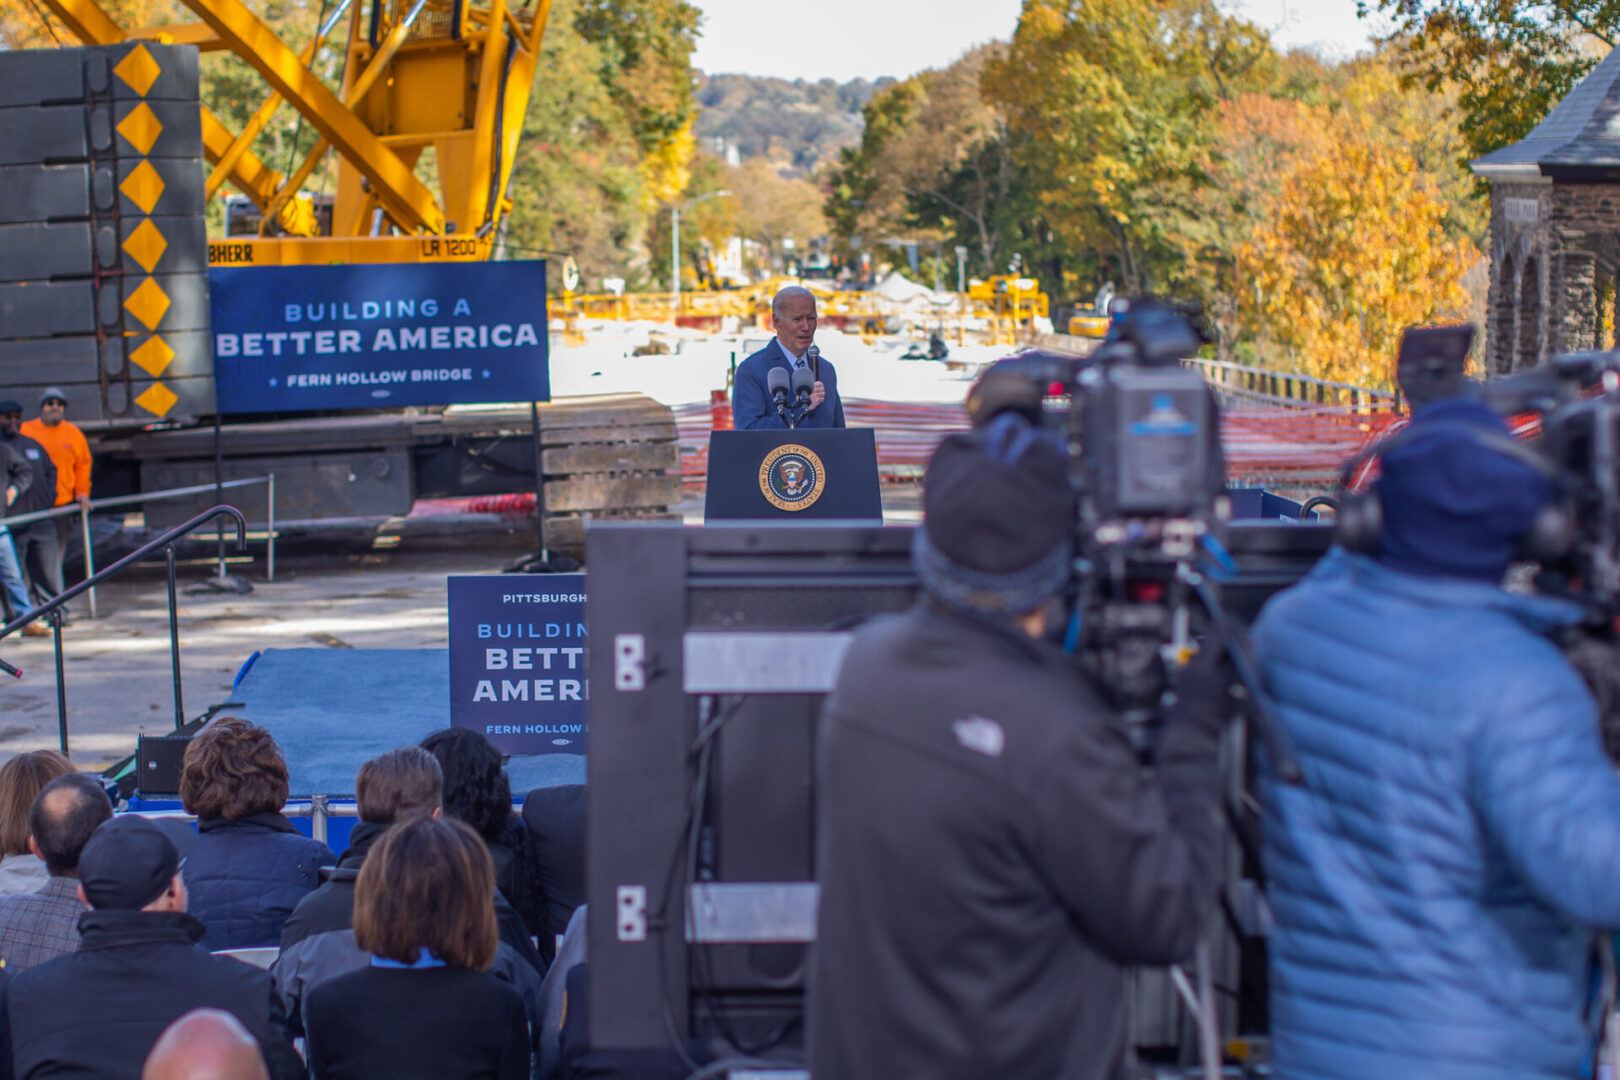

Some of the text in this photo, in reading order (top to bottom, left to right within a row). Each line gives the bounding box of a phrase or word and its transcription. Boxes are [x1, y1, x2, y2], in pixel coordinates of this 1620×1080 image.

[422, 239, 476, 256] LR 1200
[285, 298, 472, 323] BUILDING A
[216, 323, 538, 357] BETTER AMERICA
[287, 368, 473, 388] FERN HOLLOW BRIDGE
[761, 447, 792, 476] PRESIDENT
[810, 455, 824, 483] UNITED
[769, 494, 785, 508] SEAL
[796, 488, 820, 508] STATES
[503, 593, 588, 604] PITTSBURGH
[485, 647, 589, 670] BETT
[486, 724, 521, 734] FERN
[525, 723, 582, 734] HOLLOW
